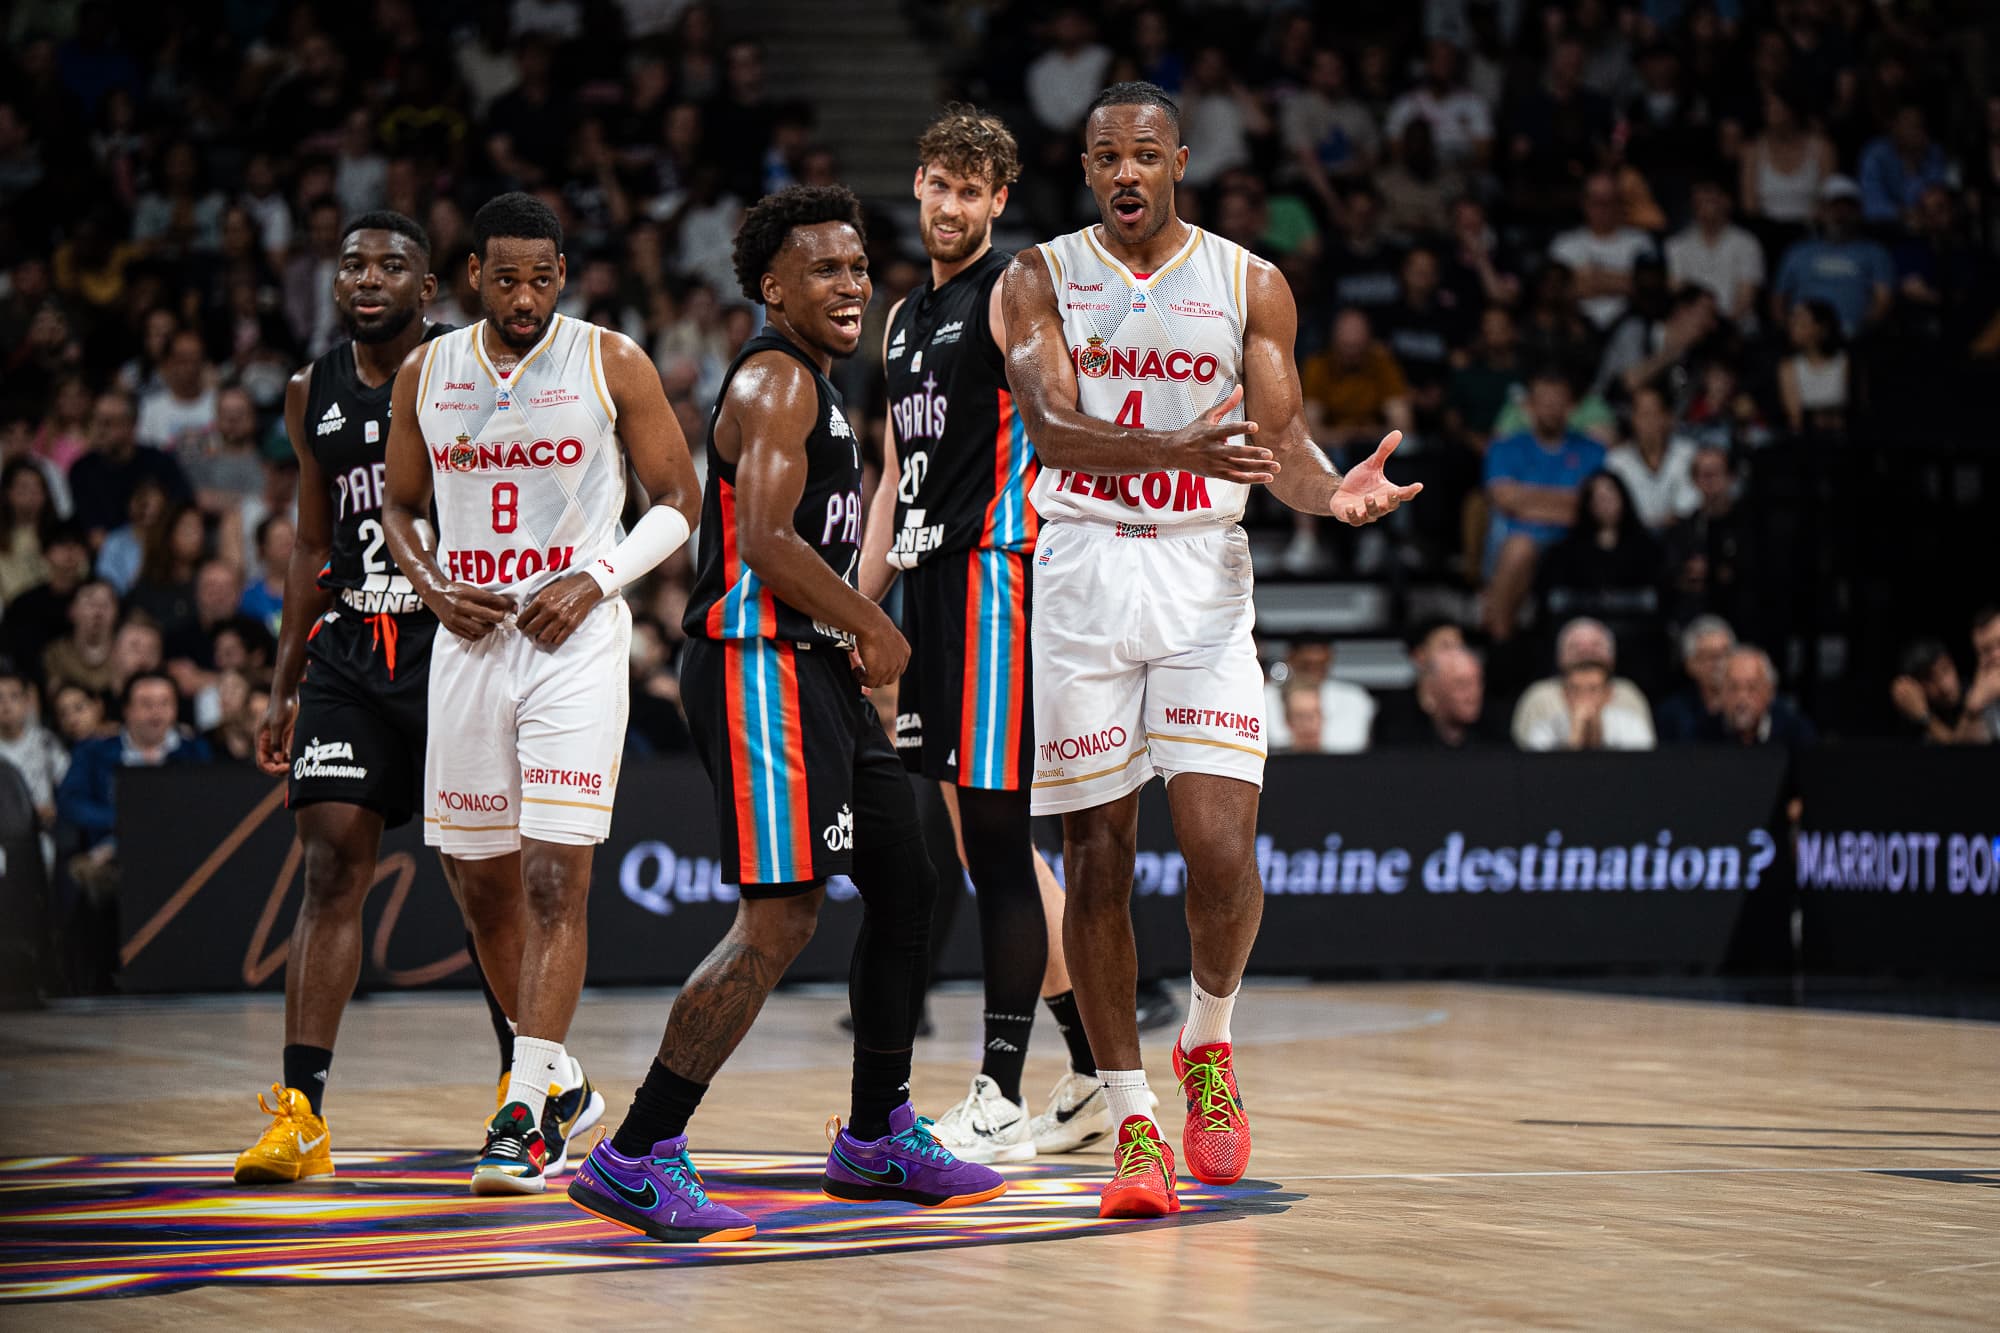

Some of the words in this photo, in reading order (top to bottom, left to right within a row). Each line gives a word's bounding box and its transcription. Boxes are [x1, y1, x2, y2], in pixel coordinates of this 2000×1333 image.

[1115, 390, 1144, 428] 4
[431, 437, 585, 473] MONACO
[336, 463, 386, 522] PAR
[492, 482, 518, 534] 8
[305, 737, 353, 760] PIZZA
[1423, 829, 1776, 893] destination?
[1797, 831, 1940, 893] MARRIOTT
